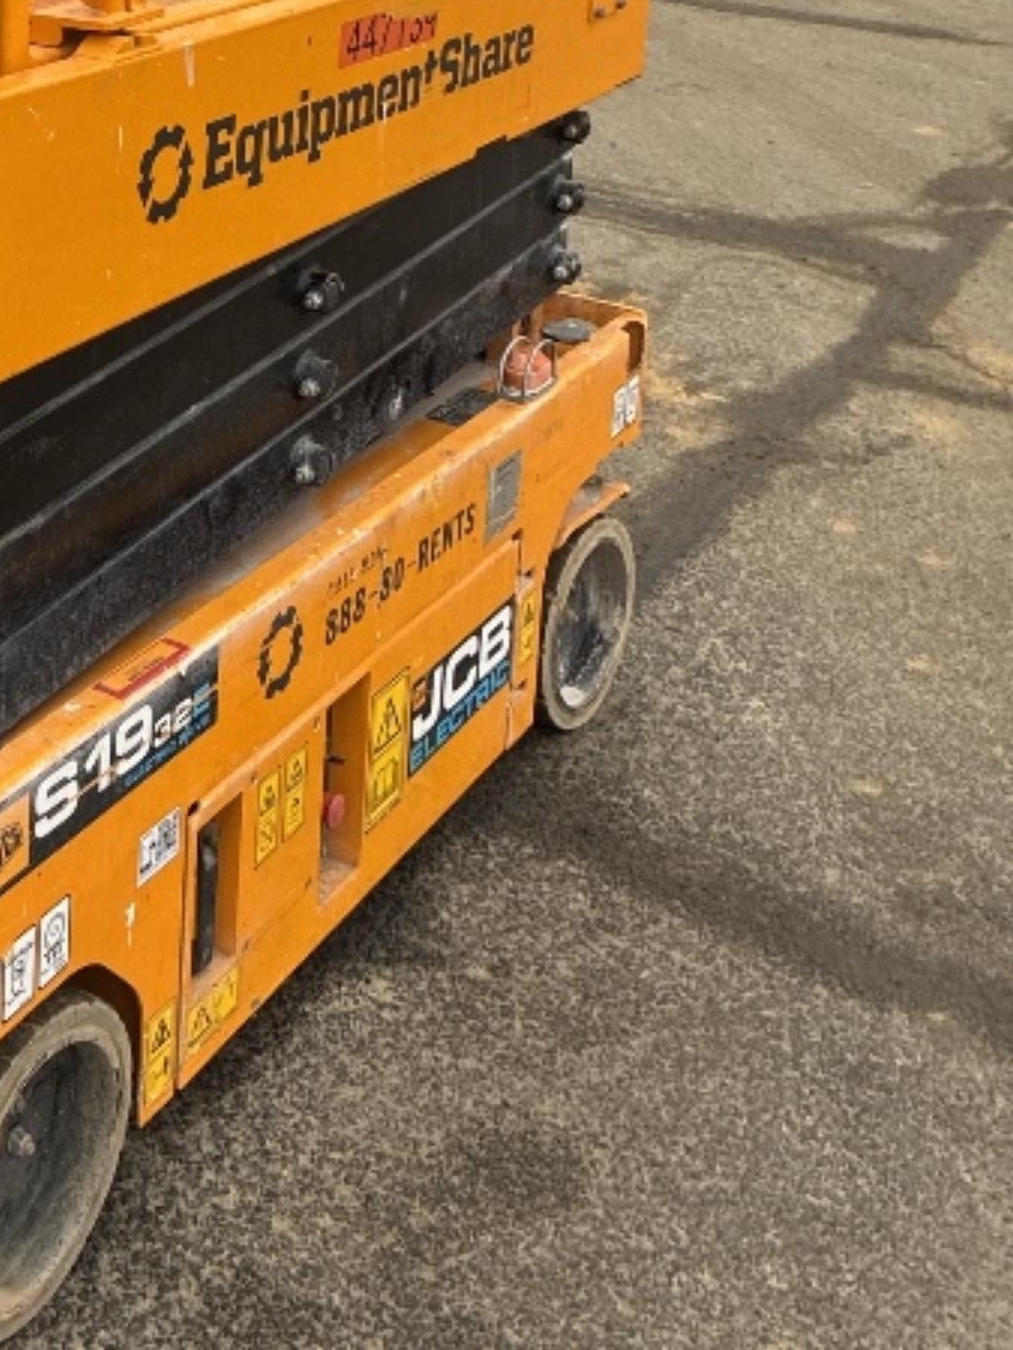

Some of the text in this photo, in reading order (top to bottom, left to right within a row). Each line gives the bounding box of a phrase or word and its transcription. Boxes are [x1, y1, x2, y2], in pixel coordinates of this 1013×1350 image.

[202, 22, 535, 188] EquipmentShare
[410, 659, 510, 774] ELECTRIC
[412, 605, 512, 742] JCB
